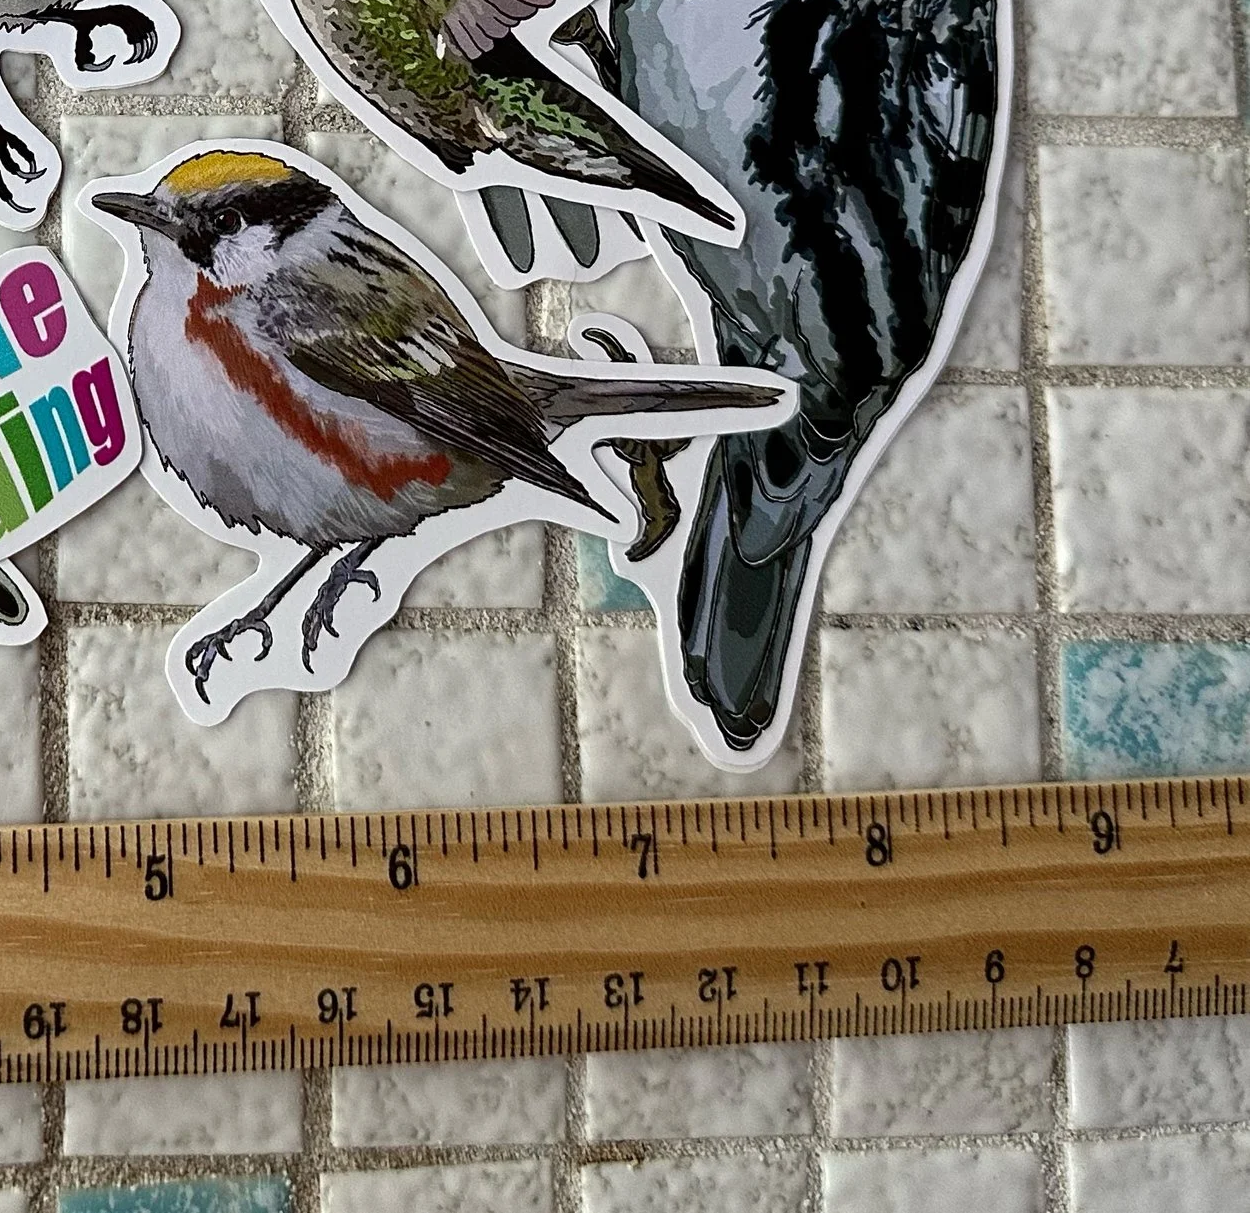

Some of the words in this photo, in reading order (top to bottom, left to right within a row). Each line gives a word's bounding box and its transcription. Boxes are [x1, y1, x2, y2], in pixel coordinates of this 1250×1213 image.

[144, 855, 168, 901] 5
[388, 845, 412, 890] 6
[632, 834, 651, 879] 7
[866, 822, 889, 866] 8
[1091, 811, 1115, 854] 9
[794, 962, 830, 995] 11
[882, 956, 922, 991] 10
[1075, 945, 1095, 978] 8
[414, 983, 454, 1018] 15
[510, 978, 551, 1012] 14
[603, 972, 644, 1008] 13
[698, 966, 738, 1003] 12
[23, 1002, 67, 1039] 19
[121, 998, 163, 1035] 18
[220, 992, 261, 1028] 17
[317, 988, 358, 1023] 16
